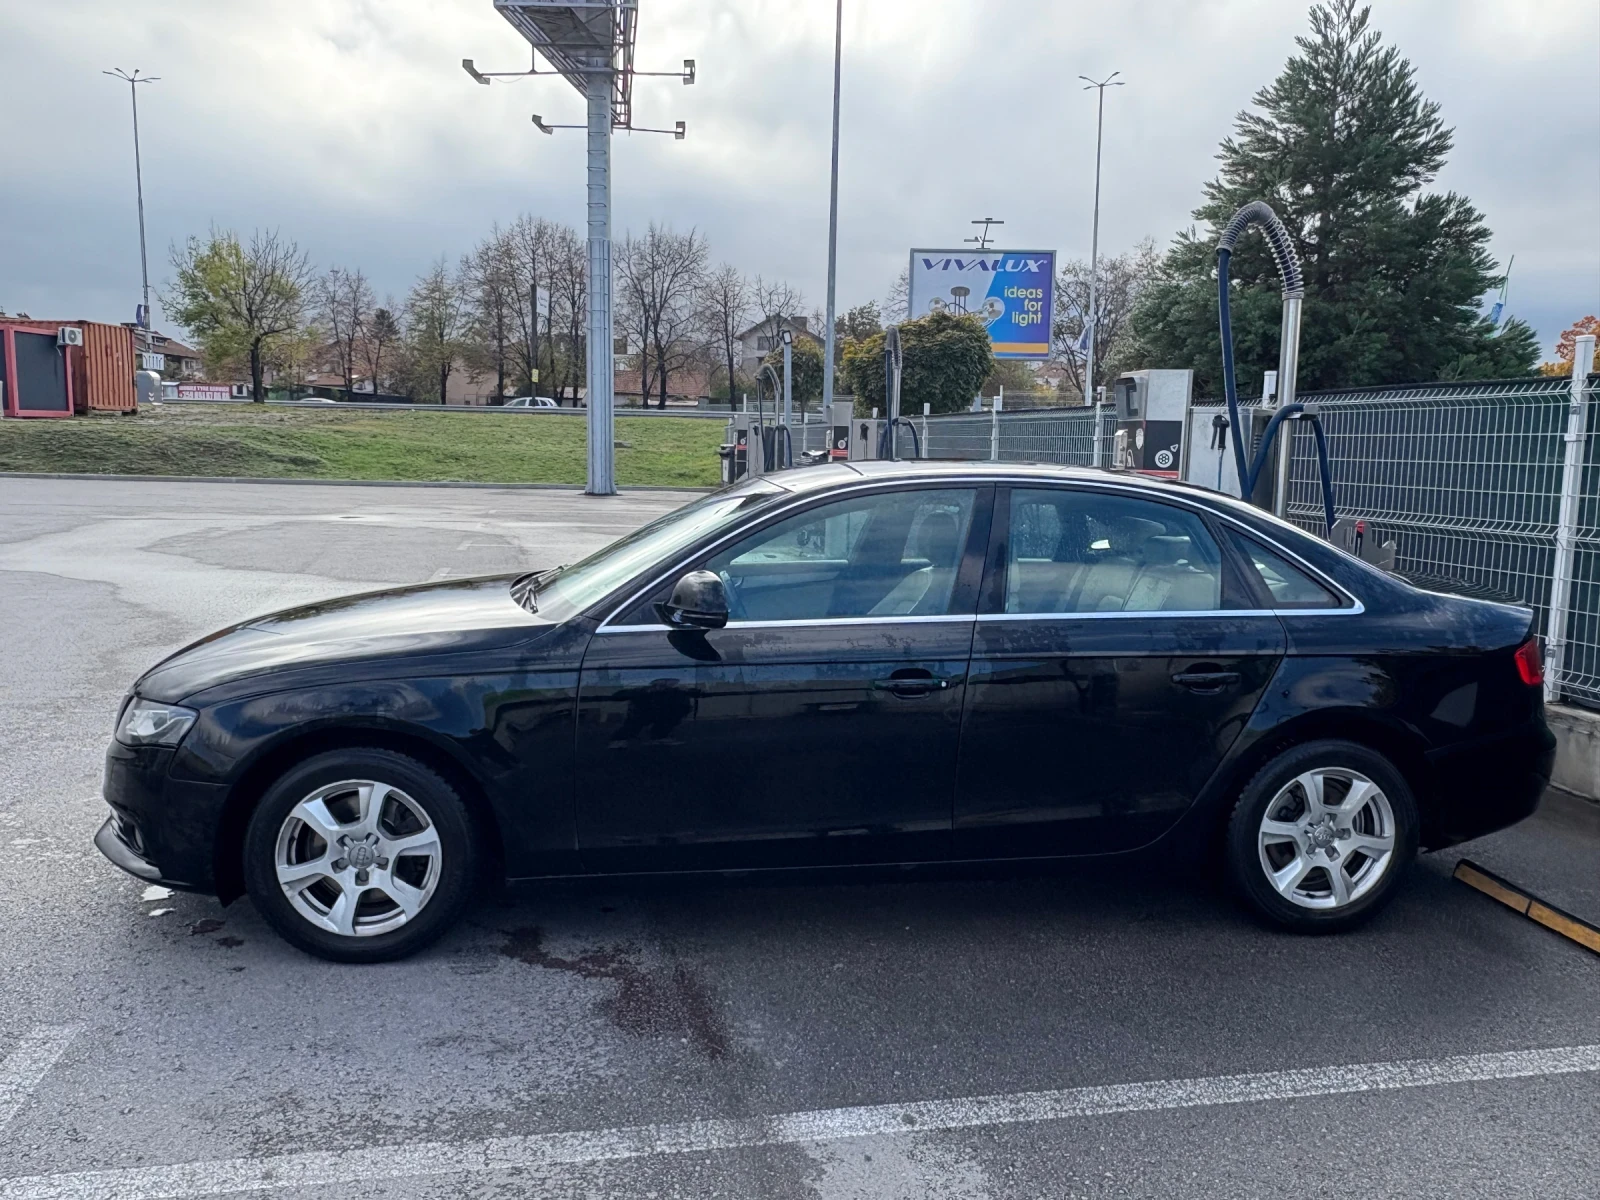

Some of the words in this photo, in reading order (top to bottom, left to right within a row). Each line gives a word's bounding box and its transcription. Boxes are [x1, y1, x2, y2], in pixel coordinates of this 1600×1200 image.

[922, 258, 1044, 272] VIVALUX
[1004, 286, 1043, 298] ideas
[1024, 299, 1042, 311] for
[1012, 312, 1042, 327] light
